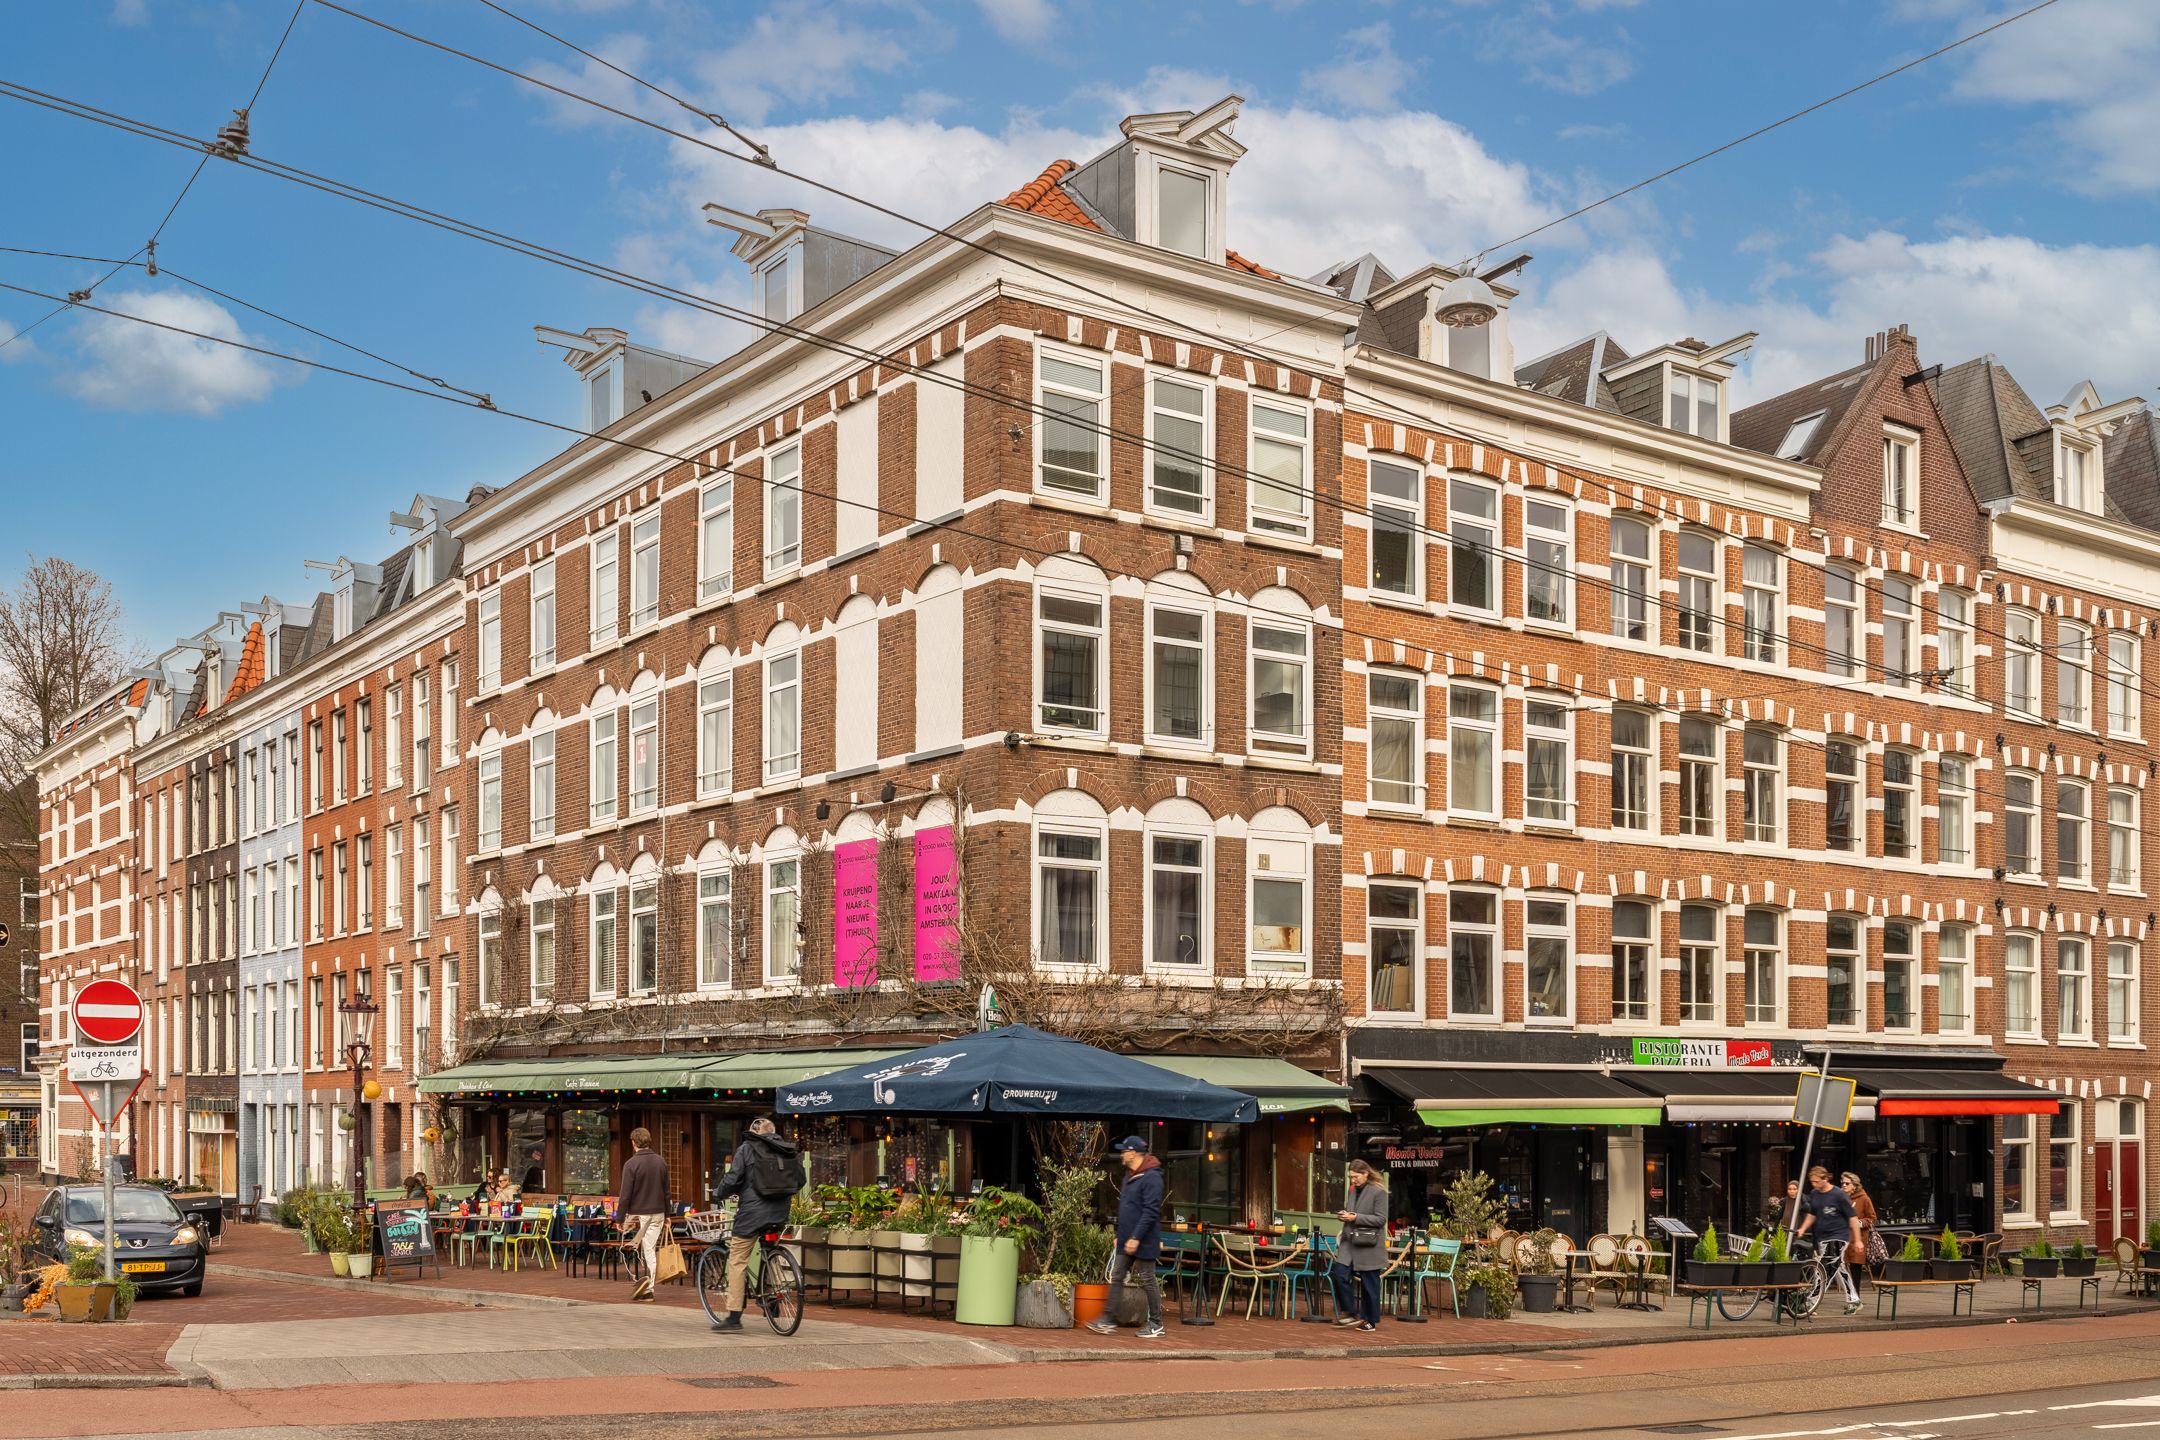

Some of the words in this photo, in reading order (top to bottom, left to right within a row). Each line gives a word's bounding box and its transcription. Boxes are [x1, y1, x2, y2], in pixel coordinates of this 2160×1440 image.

[931, 874, 950, 885] JOUW
[843, 885, 873, 897] KRUIPEND
[845, 901, 861, 910] NAAR
[863, 900, 870, 908] JE
[924, 906, 932, 915] IN
[846, 913, 869, 924] NIEUWE
[71, 1049, 138, 1059] uitgezonderd
[1639, 1042, 1721, 1056] RISTORANTE
[1651, 1056, 1711, 1066] PIZZERIA
[1729, 1053, 1750, 1066] Monte
[1750, 1046, 1769, 1062] Verde
[565, 1078, 578, 1089] Café
[1002, 1089, 1045, 1100] BROUWERIJ
[1386, 1146, 1416, 1159] Monte
[1418, 1145, 1444, 1159] Verde
[1391, 1160, 1406, 1168] ETEN
[1413, 1160, 1439, 1168] DRINKEN
[386, 1221, 420, 1238] BUITEN
[392, 1241, 415, 1251] TABLE
[390, 1249, 412, 1257] SERVICE
